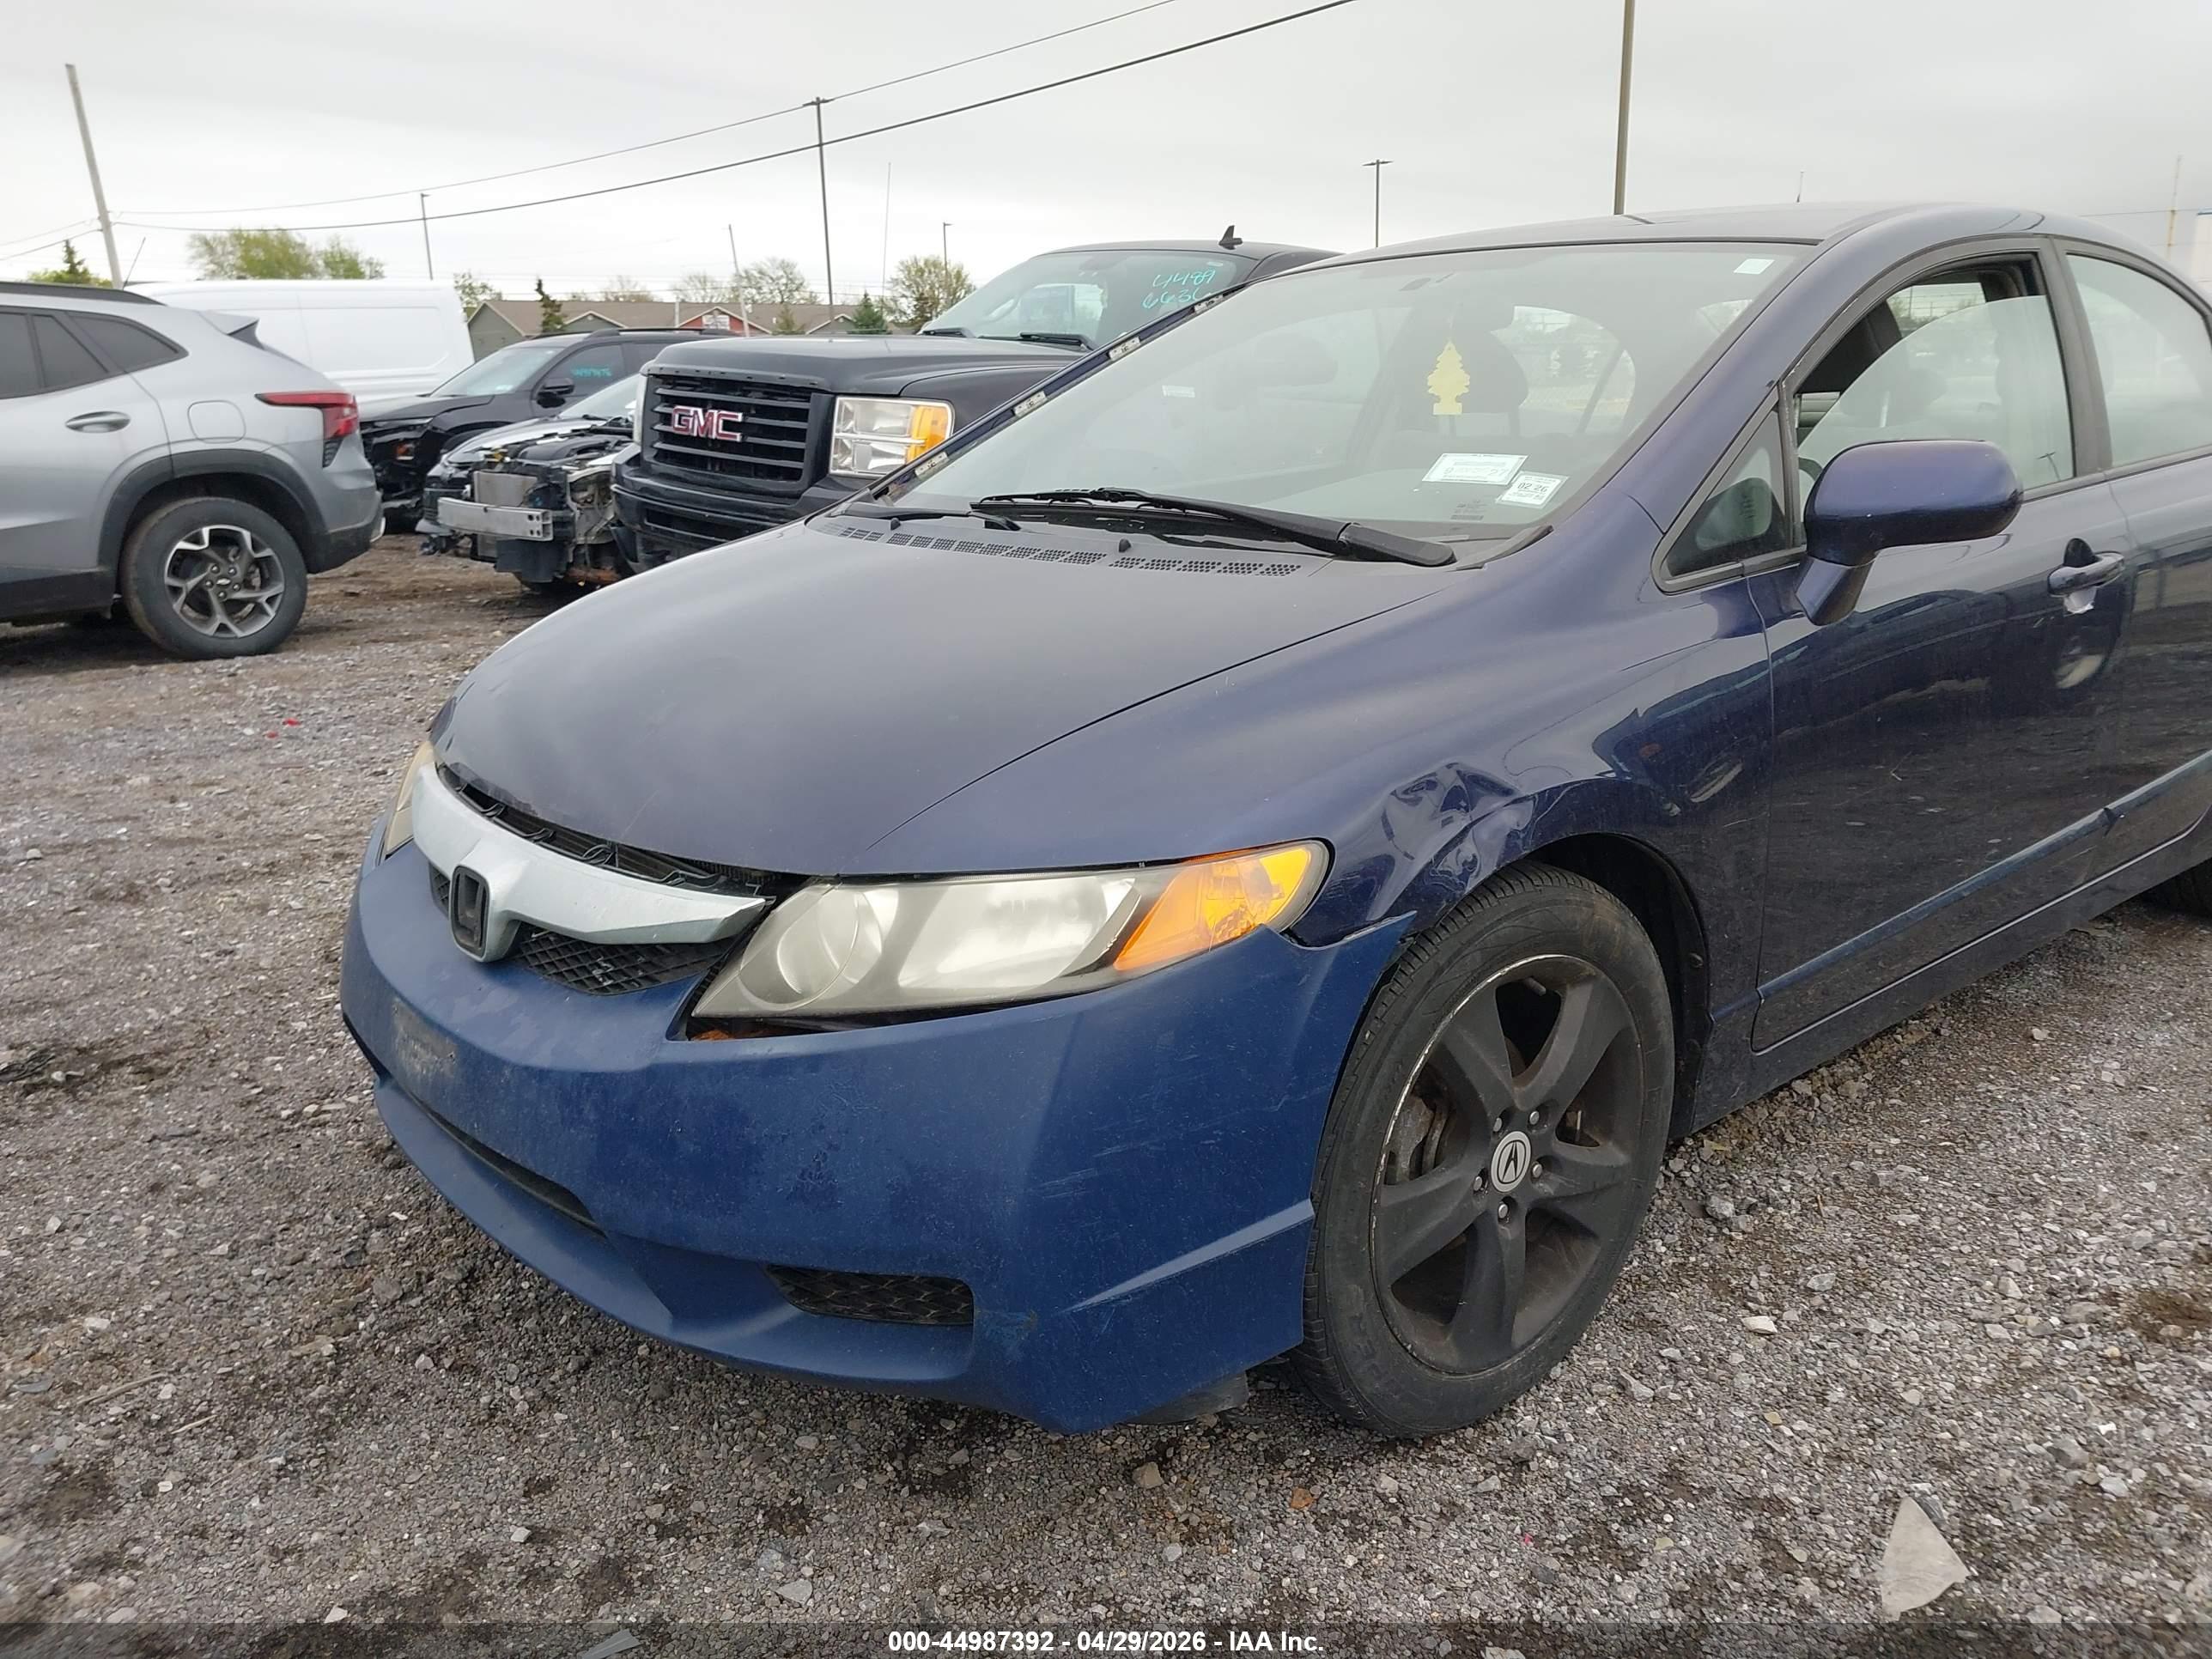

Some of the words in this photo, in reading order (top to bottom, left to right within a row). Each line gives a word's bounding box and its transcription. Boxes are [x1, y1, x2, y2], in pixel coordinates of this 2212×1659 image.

[1152, 267, 1216, 289] 4489
[672, 404, 743, 442] GMC
[1517, 482, 1533, 490] 02
